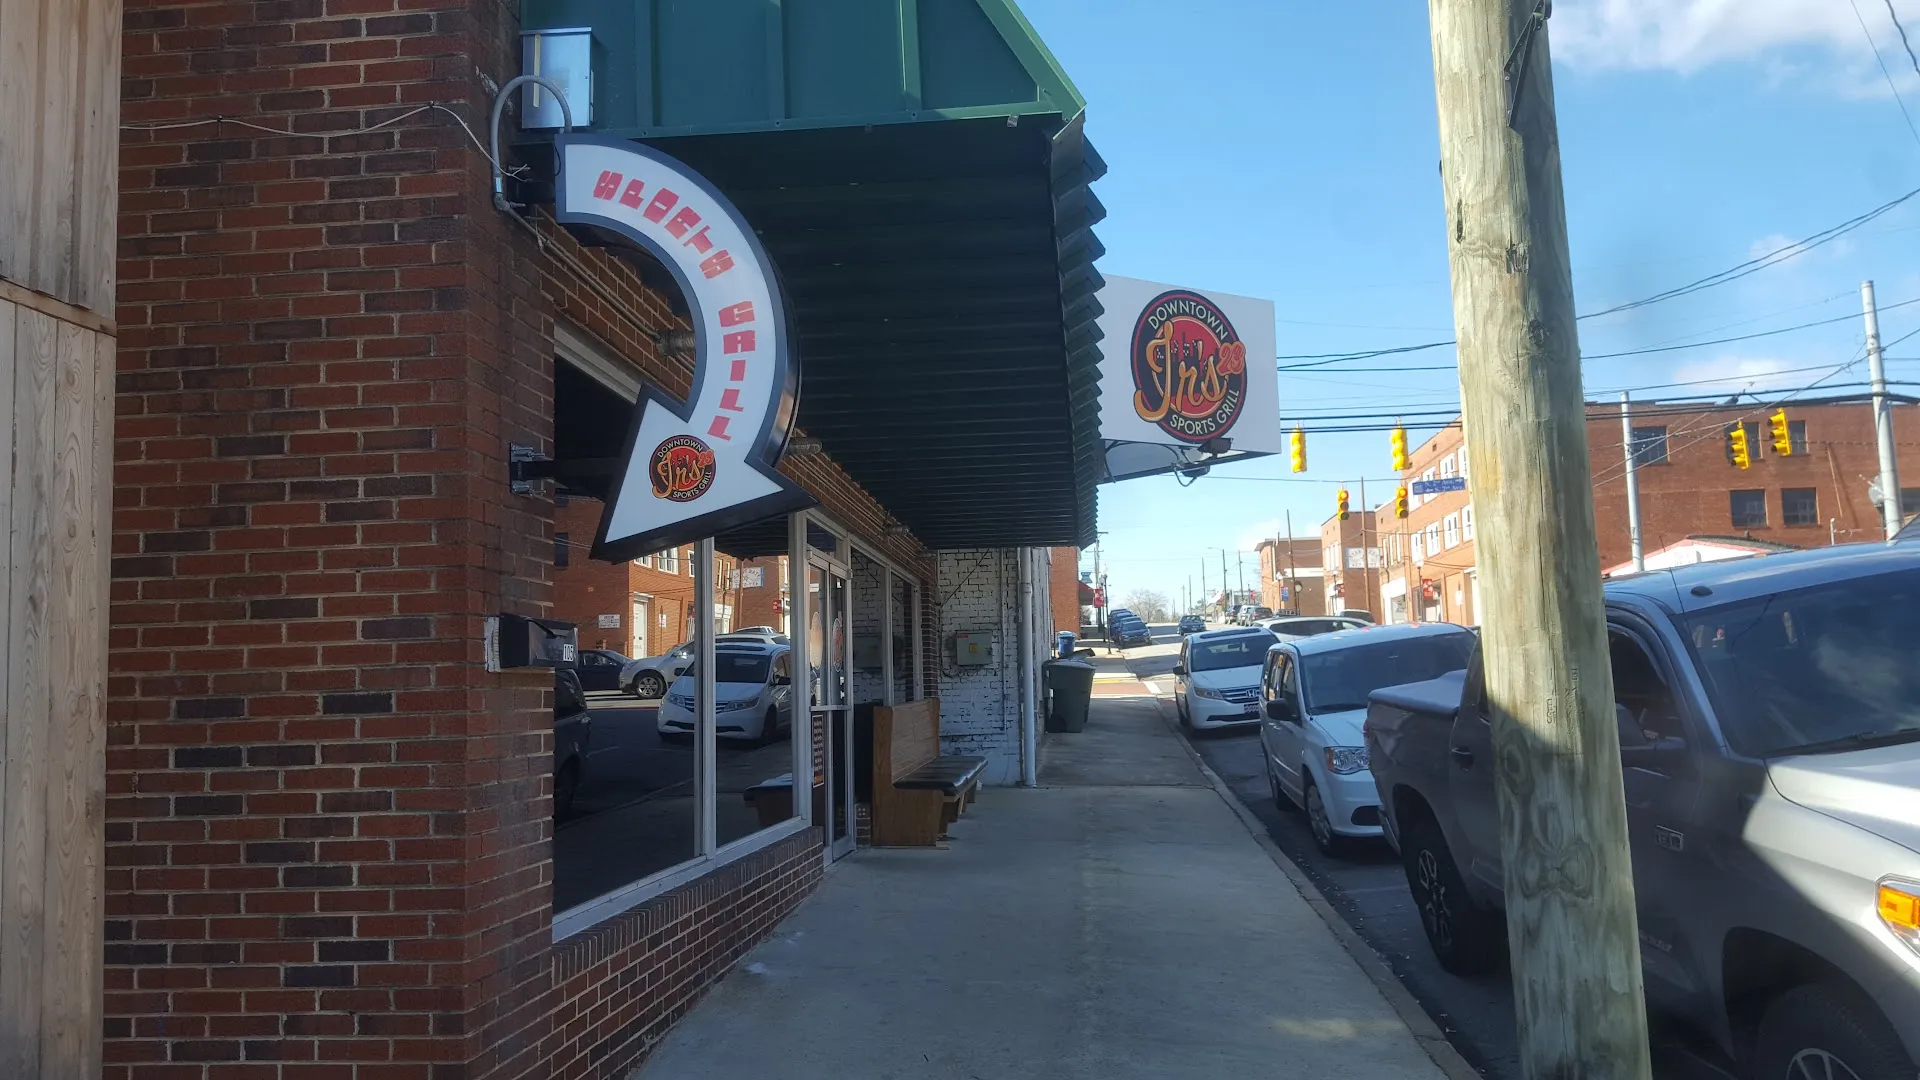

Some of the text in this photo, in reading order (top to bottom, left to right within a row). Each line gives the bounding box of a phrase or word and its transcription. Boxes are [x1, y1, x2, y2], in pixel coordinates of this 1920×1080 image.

[593, 170, 756, 441] SPORTS GRILL
[1147, 300, 1229, 340] DOWNTOWN
[1170, 389, 1239, 435] SPORTS GRILL
[657, 438, 703, 458] DOWNTOWN
[673, 471, 712, 498] SPORTS GRILL
